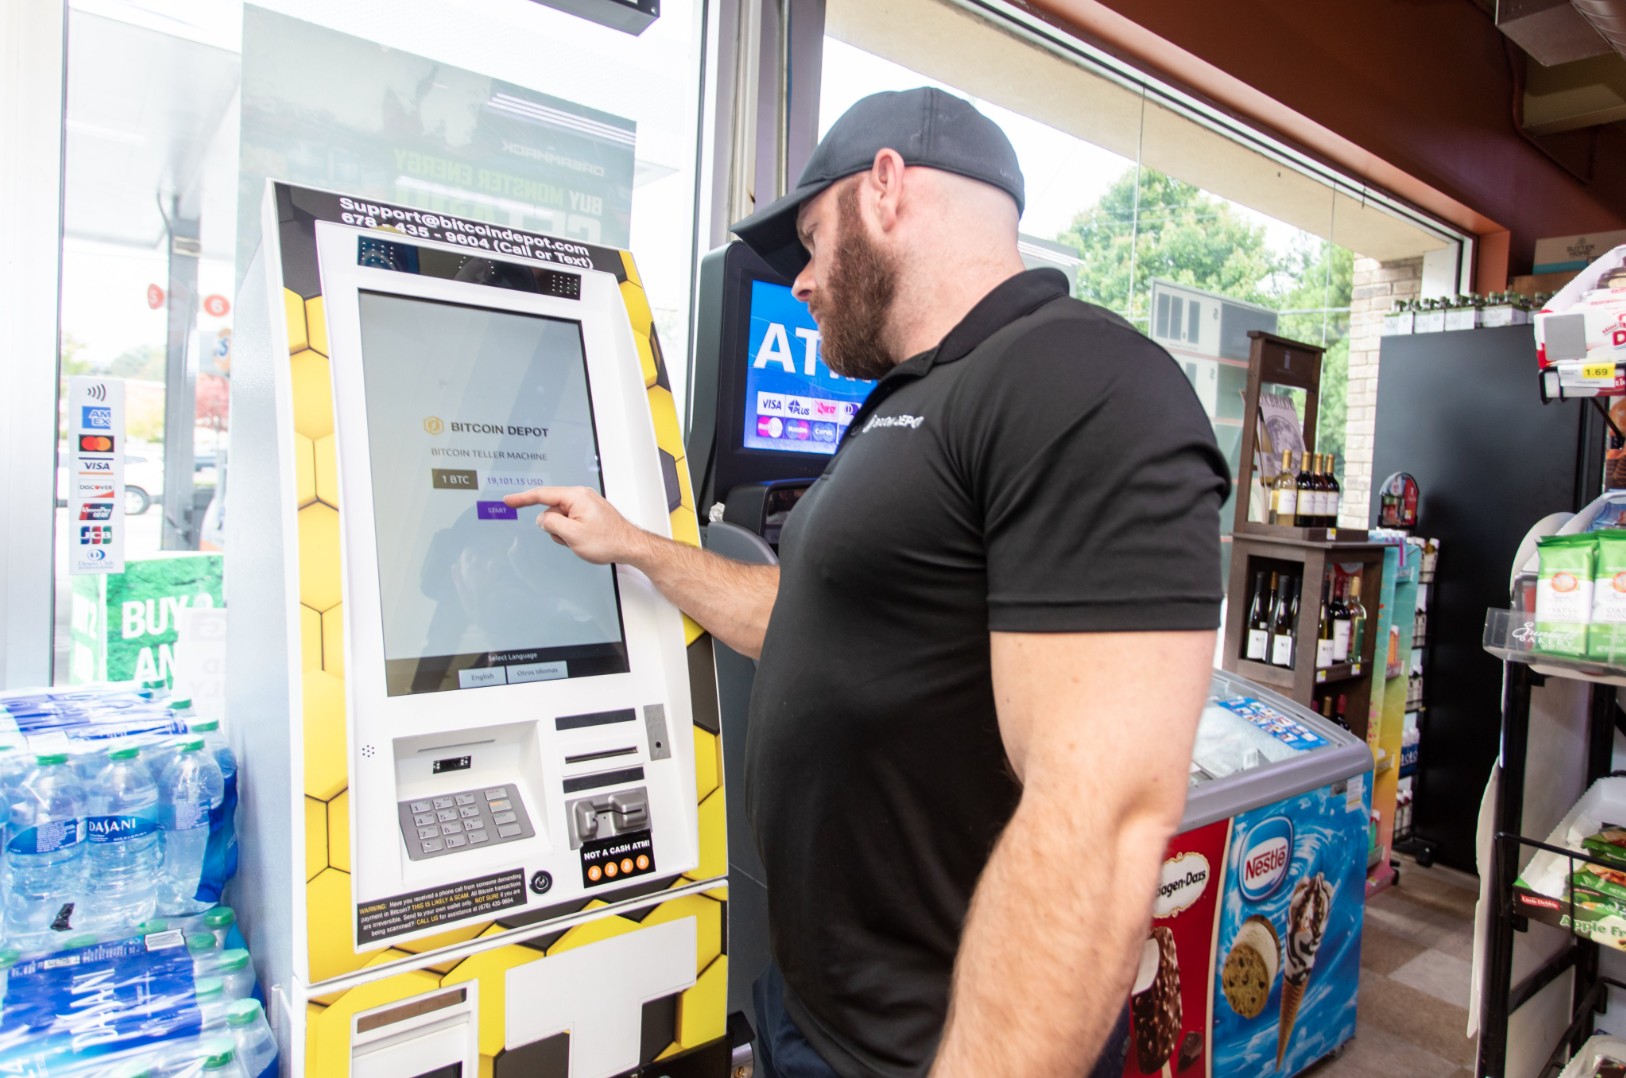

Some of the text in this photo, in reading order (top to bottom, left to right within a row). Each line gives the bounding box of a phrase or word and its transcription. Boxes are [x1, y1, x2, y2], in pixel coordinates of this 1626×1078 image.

[340, 197, 590, 256] Support@bitcoindepot.com
[342, 213, 378, 229] 678
[395, 222, 429, 239] 435
[446, 233, 490, 250] 9604
[493, 240, 532, 257] (Call
[536, 249, 552, 260] or
[554, 250, 594, 270] Text)
[1585, 368, 1608, 377] 1.69
[762, 398, 782, 411] VISA
[793, 405, 810, 416] PLUS
[451, 422, 549, 438] BITCOIN DEPOT
[431, 447, 548, 461] BITCOIN TELLER MACHINE
[84, 461, 111, 470] VISA
[450, 475, 470, 485] BTC
[527, 478, 544, 486] USD
[488, 652, 538, 662] Select Language
[470, 671, 495, 682] English
[89, 817, 136, 835] DASANI
[583, 839, 651, 861] NOT A CASH ATM!
[390, 899, 403, 908] Have
[403, 898, 413, 906] you
[414, 893, 434, 902] received
[439, 887, 455, 897] phone
[476, 879, 497, 888] someone
[497, 874, 522, 883] demanding
[360, 912, 383, 923] payment
[411, 902, 424, 910] THIS
[431, 897, 449, 906] LIKELY
[494, 881, 521, 891] transactions
[403, 913, 416, 921] Send
[423, 908, 435, 917] your
[486, 892, 500, 900] SURE
[371, 928, 386, 937] being
[416, 917, 430, 926] CALL
[447, 906, 472, 918] assistance
[1559, 914, 1607, 933] Apple
